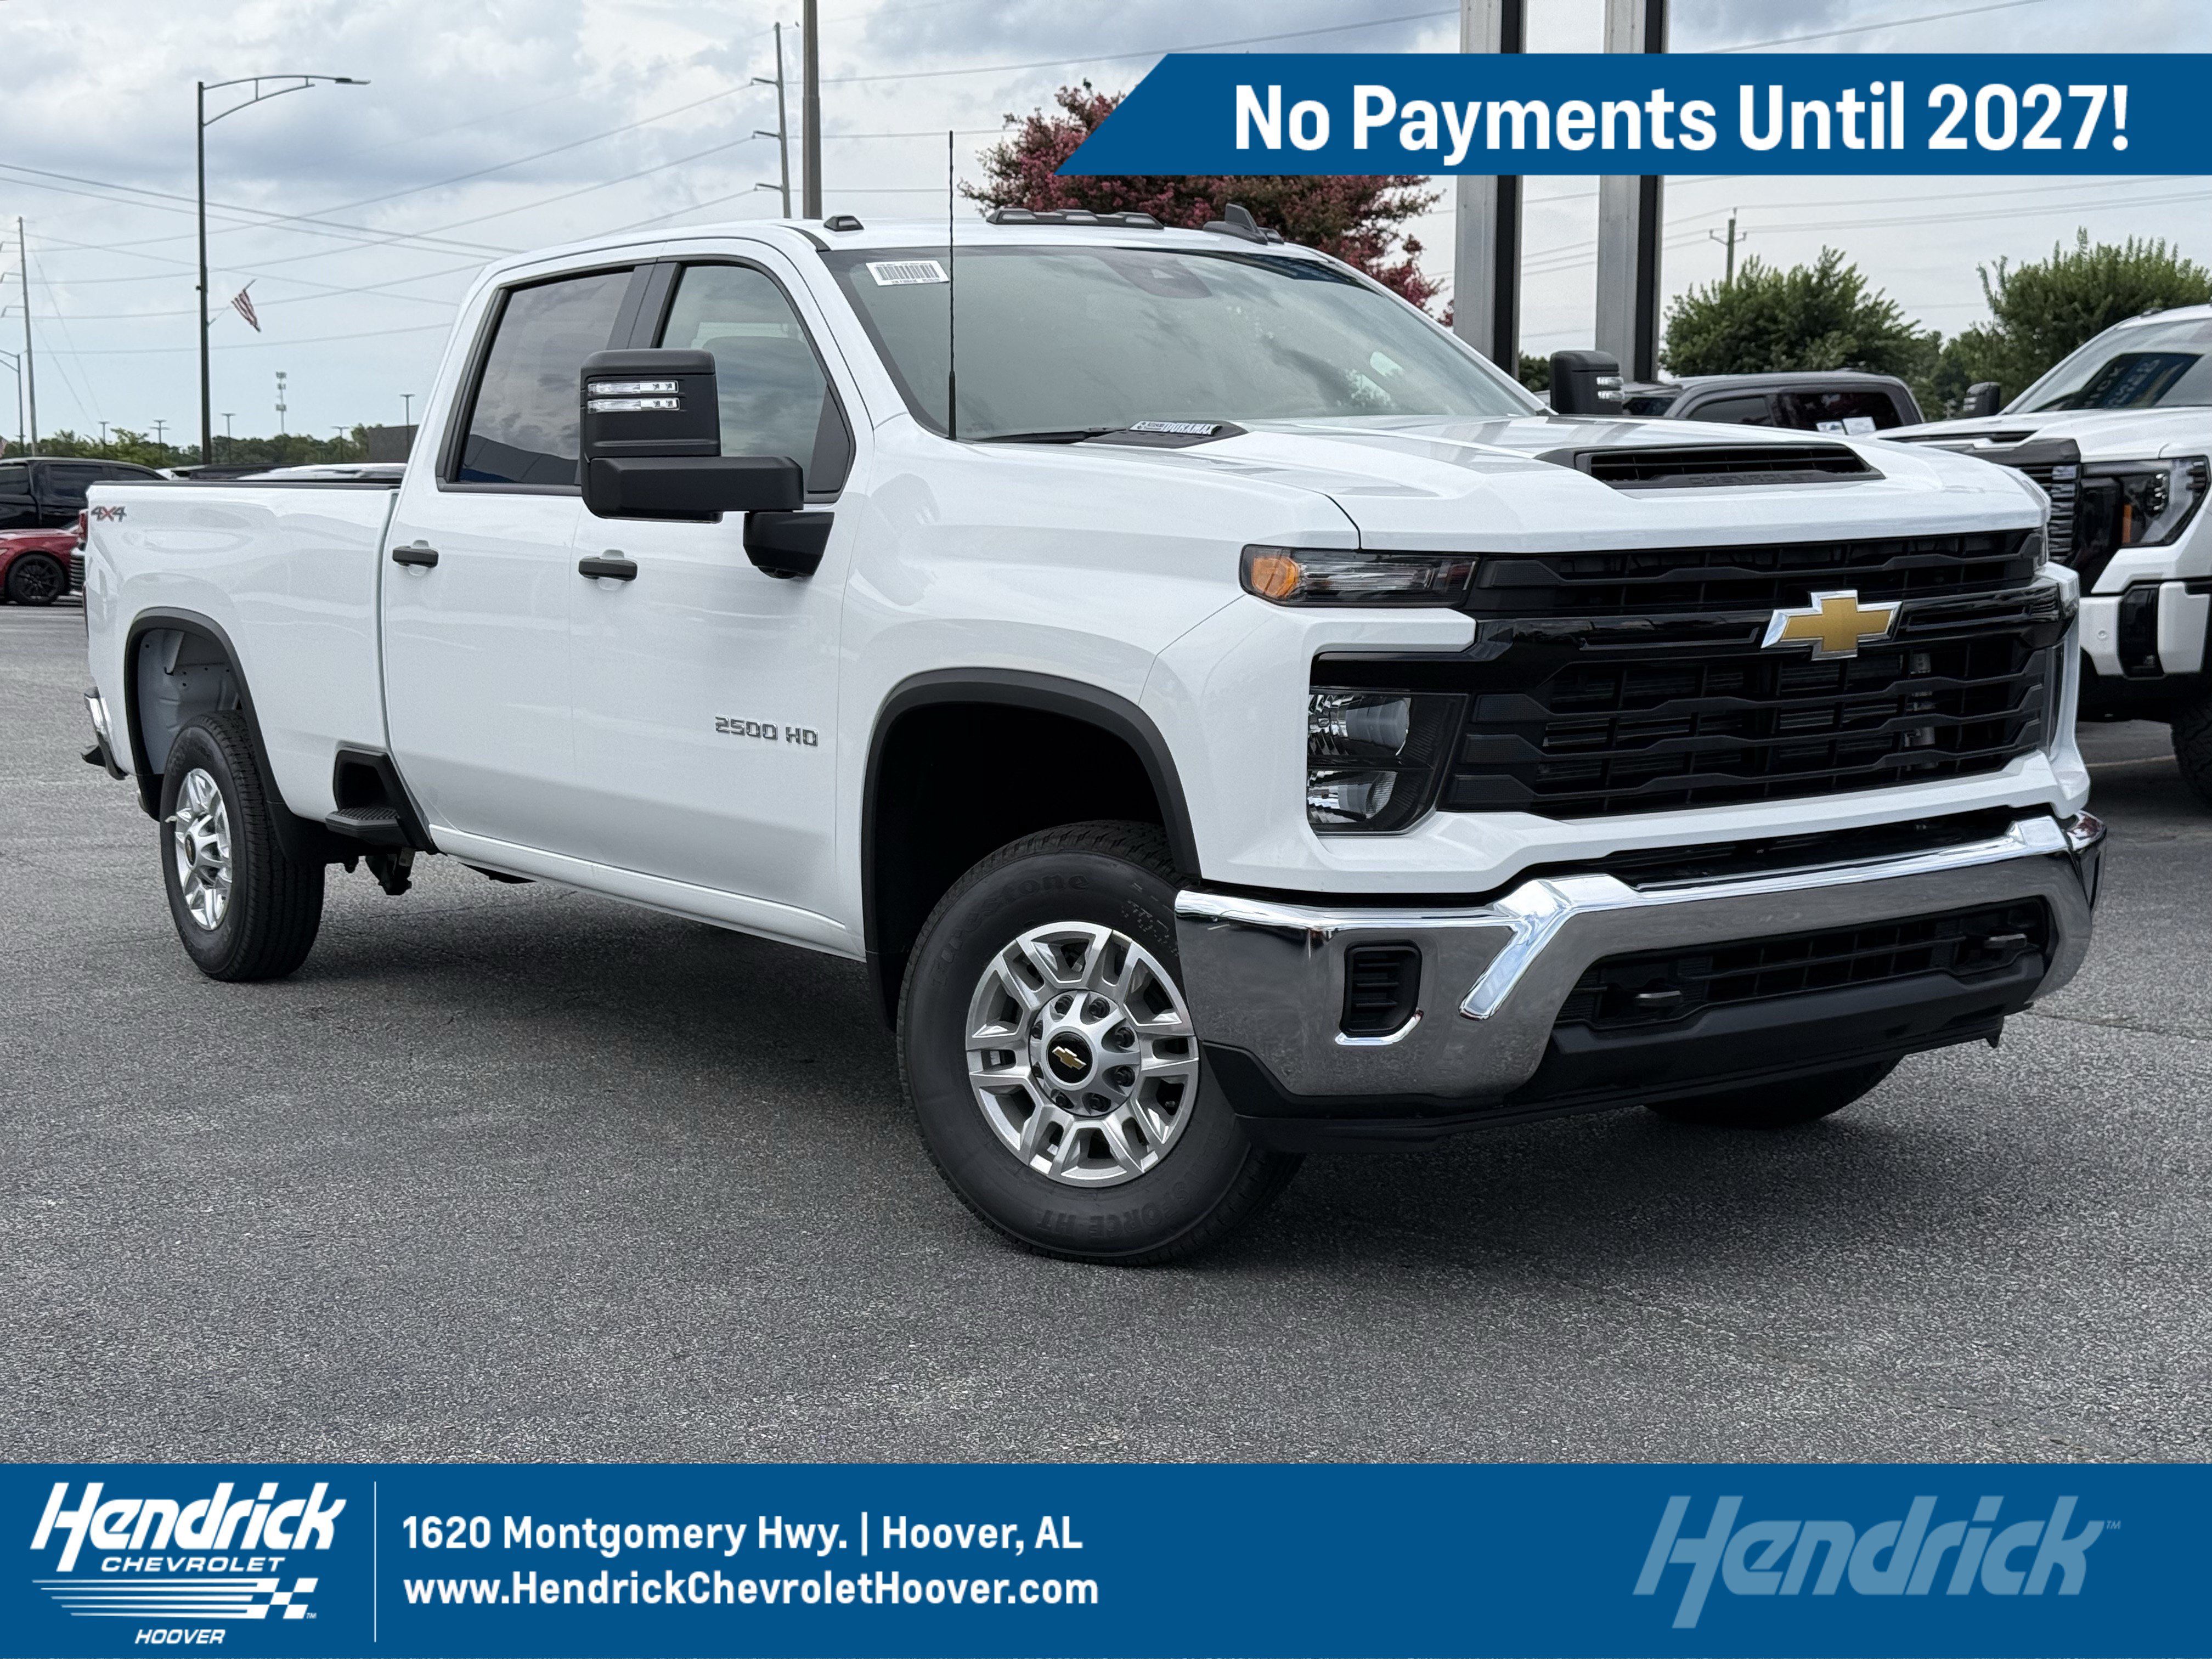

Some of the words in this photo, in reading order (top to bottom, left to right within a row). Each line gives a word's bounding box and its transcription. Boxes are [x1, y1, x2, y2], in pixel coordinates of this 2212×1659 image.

[1688, 472, 1814, 485] CHEVROLET
[715, 715, 778, 741] 2500
[786, 726, 819, 747] HD
